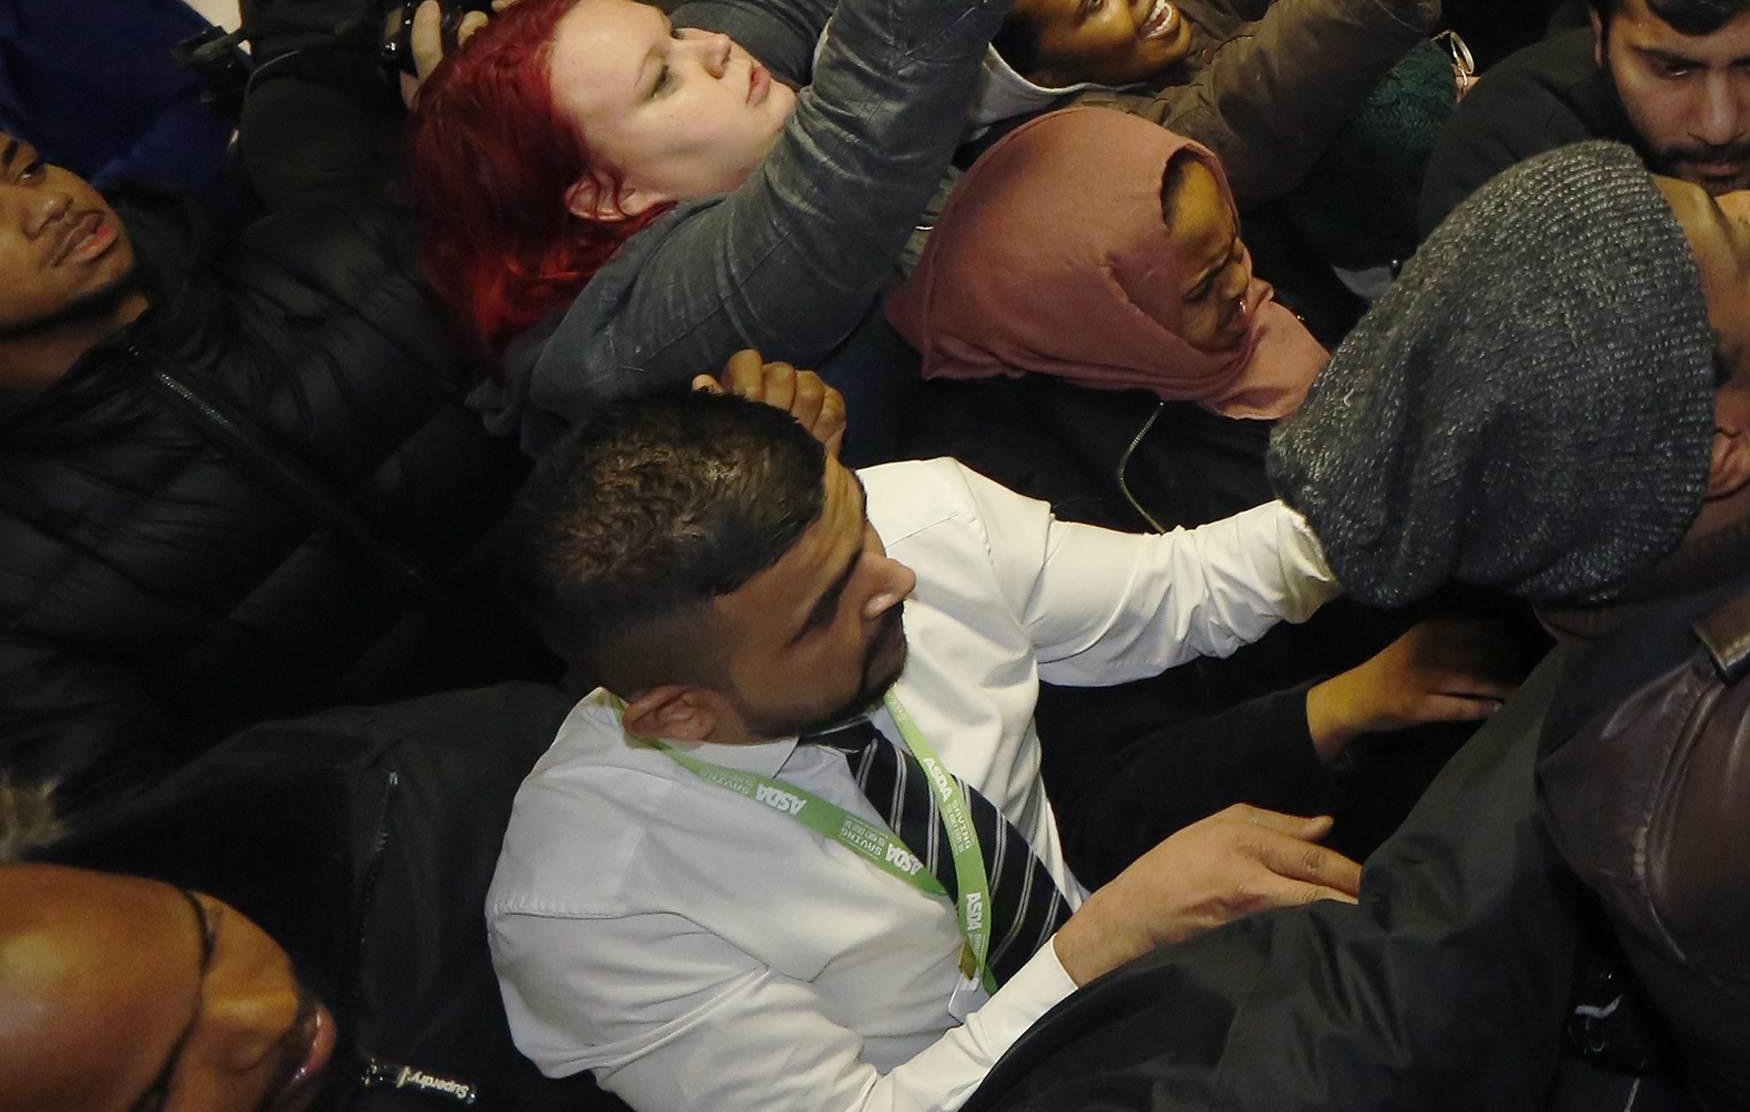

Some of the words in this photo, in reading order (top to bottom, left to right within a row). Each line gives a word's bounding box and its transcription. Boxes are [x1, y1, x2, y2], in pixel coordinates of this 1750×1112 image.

[922, 757, 954, 803] ASDA
[754, 783, 808, 815] ASDA
[840, 826, 883, 857] SAVING
[884, 842, 924, 876] ASDA
[966, 892, 983, 931] ASDA
